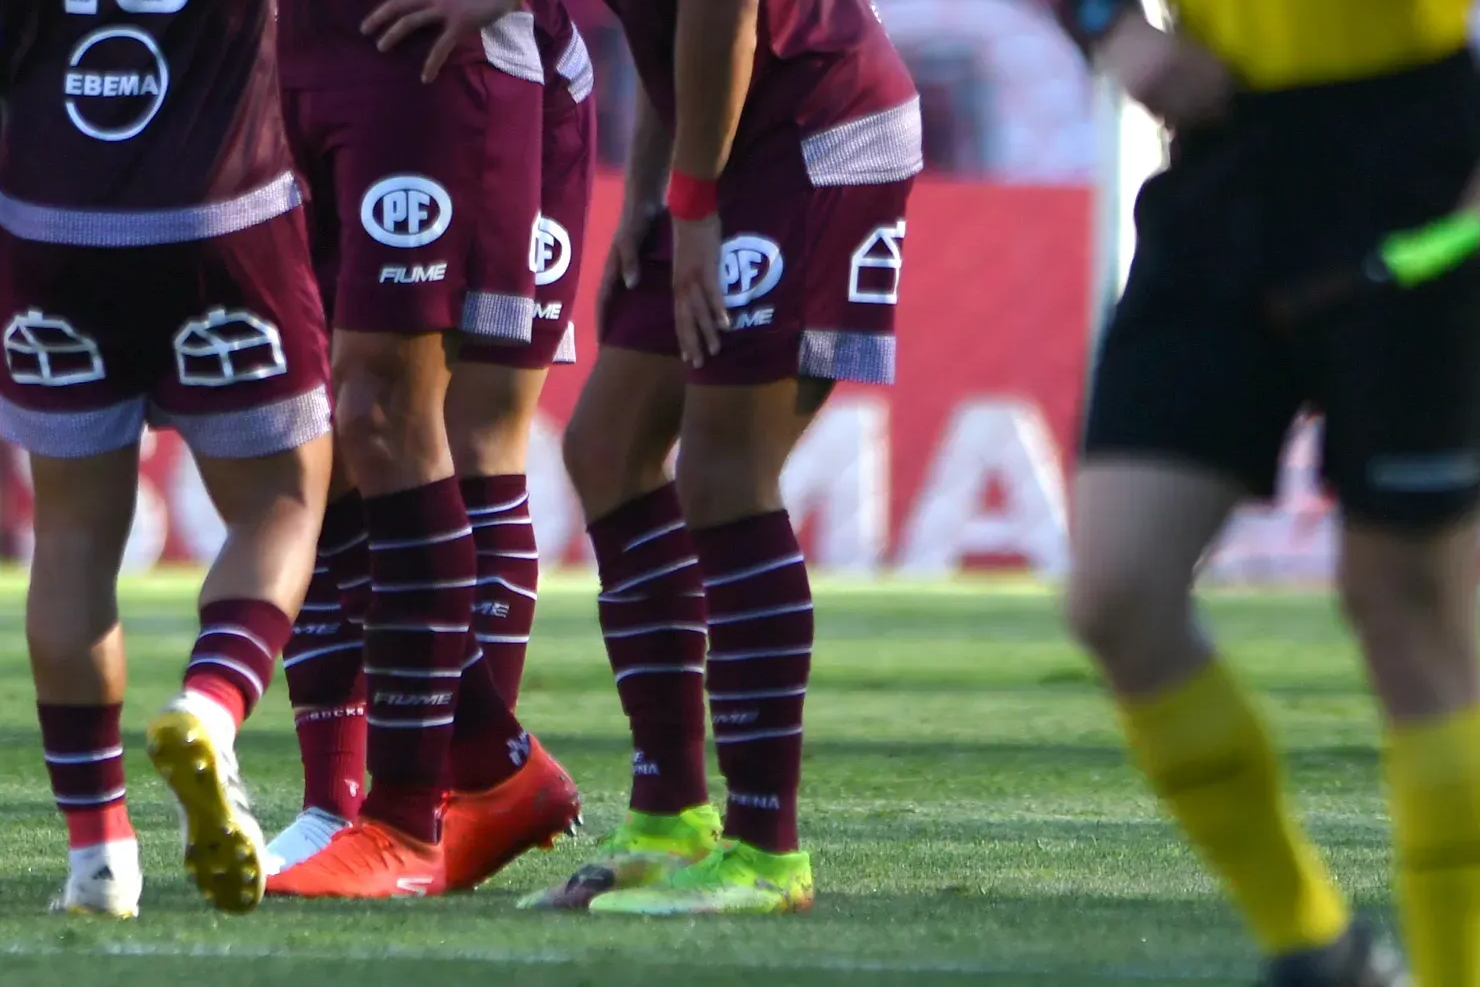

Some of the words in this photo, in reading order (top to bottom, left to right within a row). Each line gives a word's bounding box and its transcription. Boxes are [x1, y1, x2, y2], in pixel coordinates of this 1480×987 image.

[65, 71, 159, 98] EBEMA
[383, 192, 429, 235] PF
[379, 263, 447, 284] FIUME
